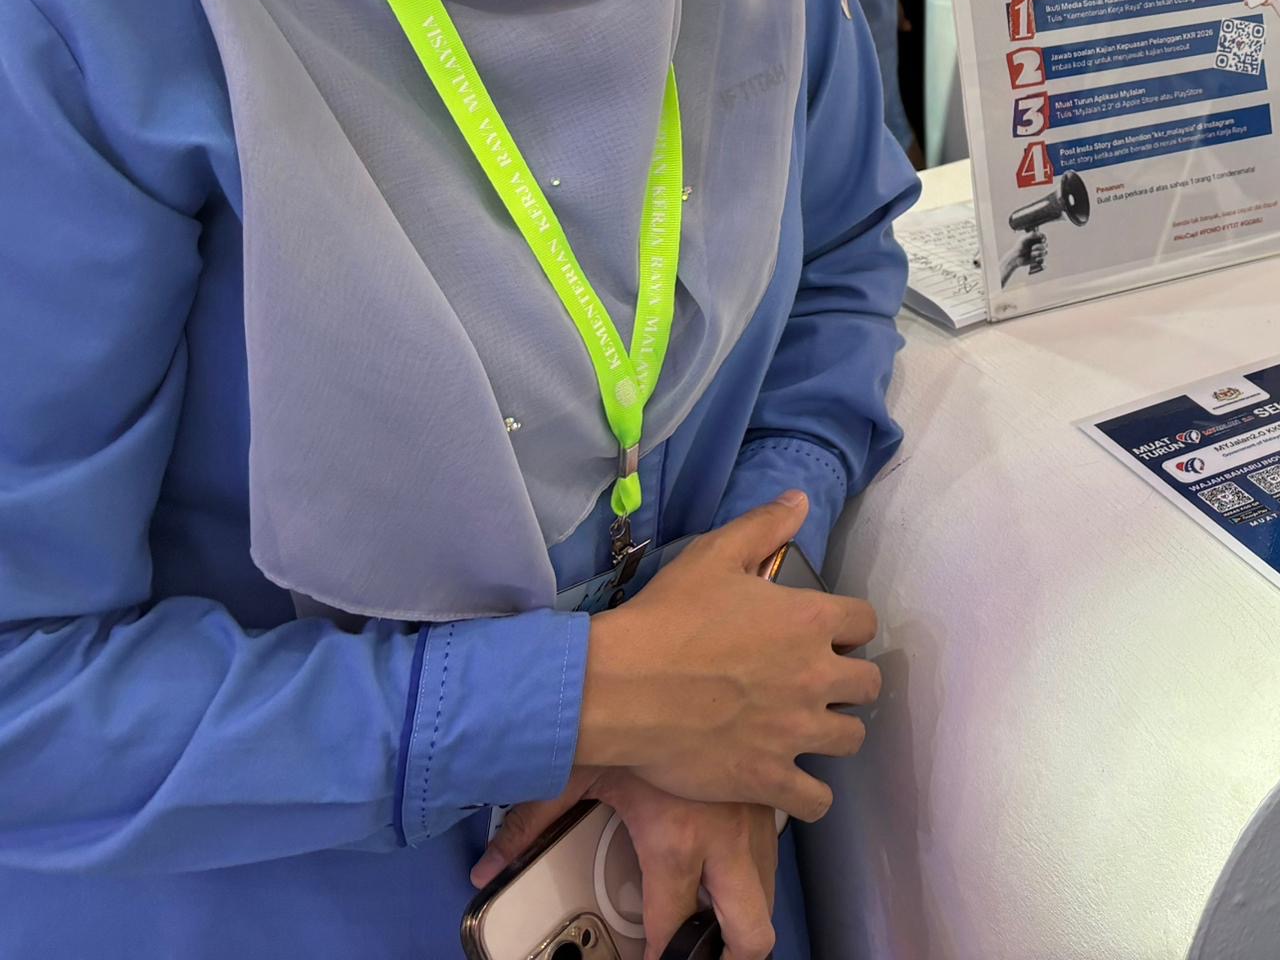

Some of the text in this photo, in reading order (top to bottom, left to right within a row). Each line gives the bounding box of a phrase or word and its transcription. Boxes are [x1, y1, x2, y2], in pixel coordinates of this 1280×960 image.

[1012, 49, 1043, 85] 2
[1016, 96, 1046, 136] 3
[1022, 143, 1051, 185] 4
[420, 14, 622, 371] KEMENTERIAN KERJA RAYA MALAYSIA
[652, 185, 670, 248] KERJA
[649, 256, 664, 306] RAYA
[1132, 436, 1173, 456] MUAT
[1138, 441, 1186, 462] TURUN
[1188, 475, 1226, 493] WAJAH
[1224, 461, 1262, 481] BAHARU
[1249, 513, 1279, 527] MUAT
